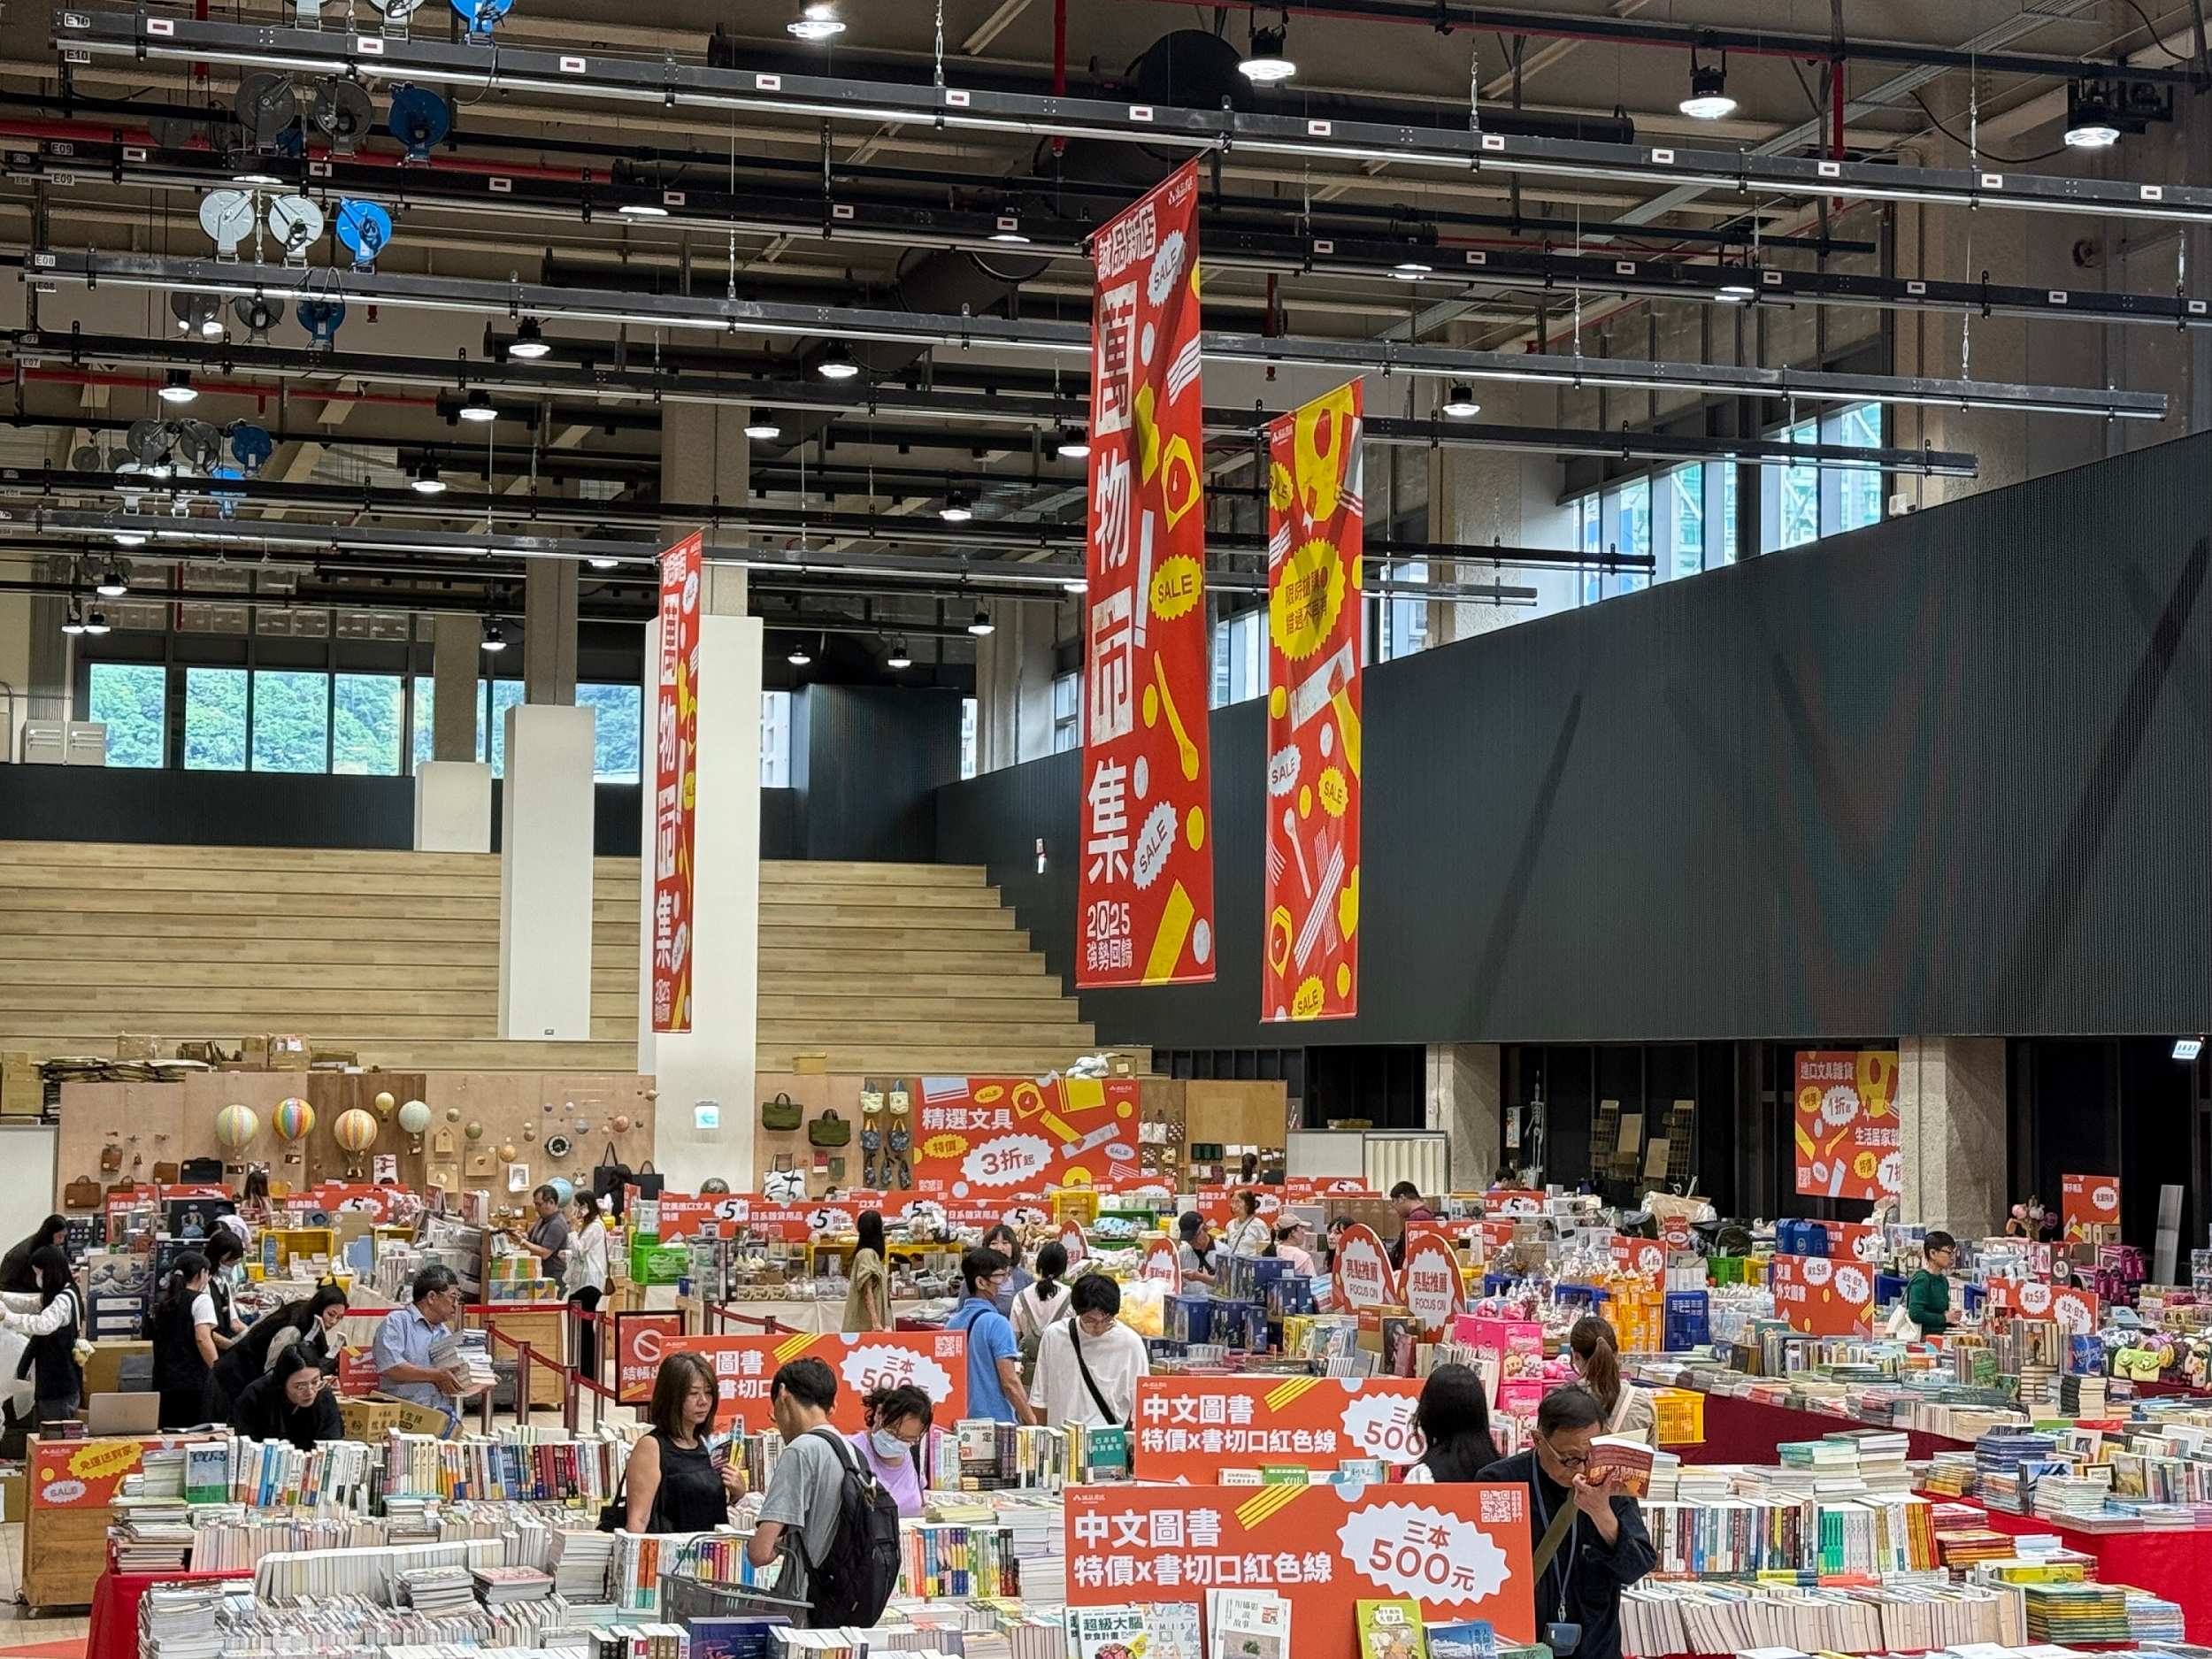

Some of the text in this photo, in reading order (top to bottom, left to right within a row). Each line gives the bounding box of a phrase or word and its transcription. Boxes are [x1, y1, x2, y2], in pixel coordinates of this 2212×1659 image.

[67, 50, 88, 60] E10
[52, 144, 72, 154] E09
[36, 256, 54, 265] E08
[1154, 247, 1177, 291] SALE
[1087, 280, 1138, 885] 萬物市集
[1157, 572, 1193, 604] SALE
[1271, 757, 1296, 785] SALE
[1324, 782, 1343, 803] SALE
[1140, 819, 1168, 874] SALE
[1087, 901, 1131, 939] 2025
[1296, 988, 1319, 1017] SALE
[1801, 1062, 1855, 1080] 進口文具雜貨
[922, 1108, 1014, 1131] 精選文具
[933, 1139, 957, 1153] 特價
[980, 1147, 1036, 1175] 3折起
[1349, 1285, 1379, 1299] FOCUS ON
[1415, 1298, 1447, 1311] FOCUS ON
[1776, 1283, 1806, 1302] 外文圖書
[883, 1356, 915, 1374] 三本
[1142, 1394, 1255, 1425] 中文圖書
[1394, 1406, 1409, 1425] 三
[1141, 1428, 1337, 1455] 特價x書切口紅色線
[1364, 1419, 1425, 1456] 500
[50, 1485, 79, 1496] SALE
[1073, 1508, 1222, 1549] 中文圖書
[1402, 1518, 1451, 1549] 三本
[1073, 1554, 1333, 1588] 特價x書切口紅色線
[1369, 1539, 1477, 1592] 500元
[1083, 1616, 1144, 1631] 超級大腦
[1084, 1632, 1119, 1640] 飲食計畫
